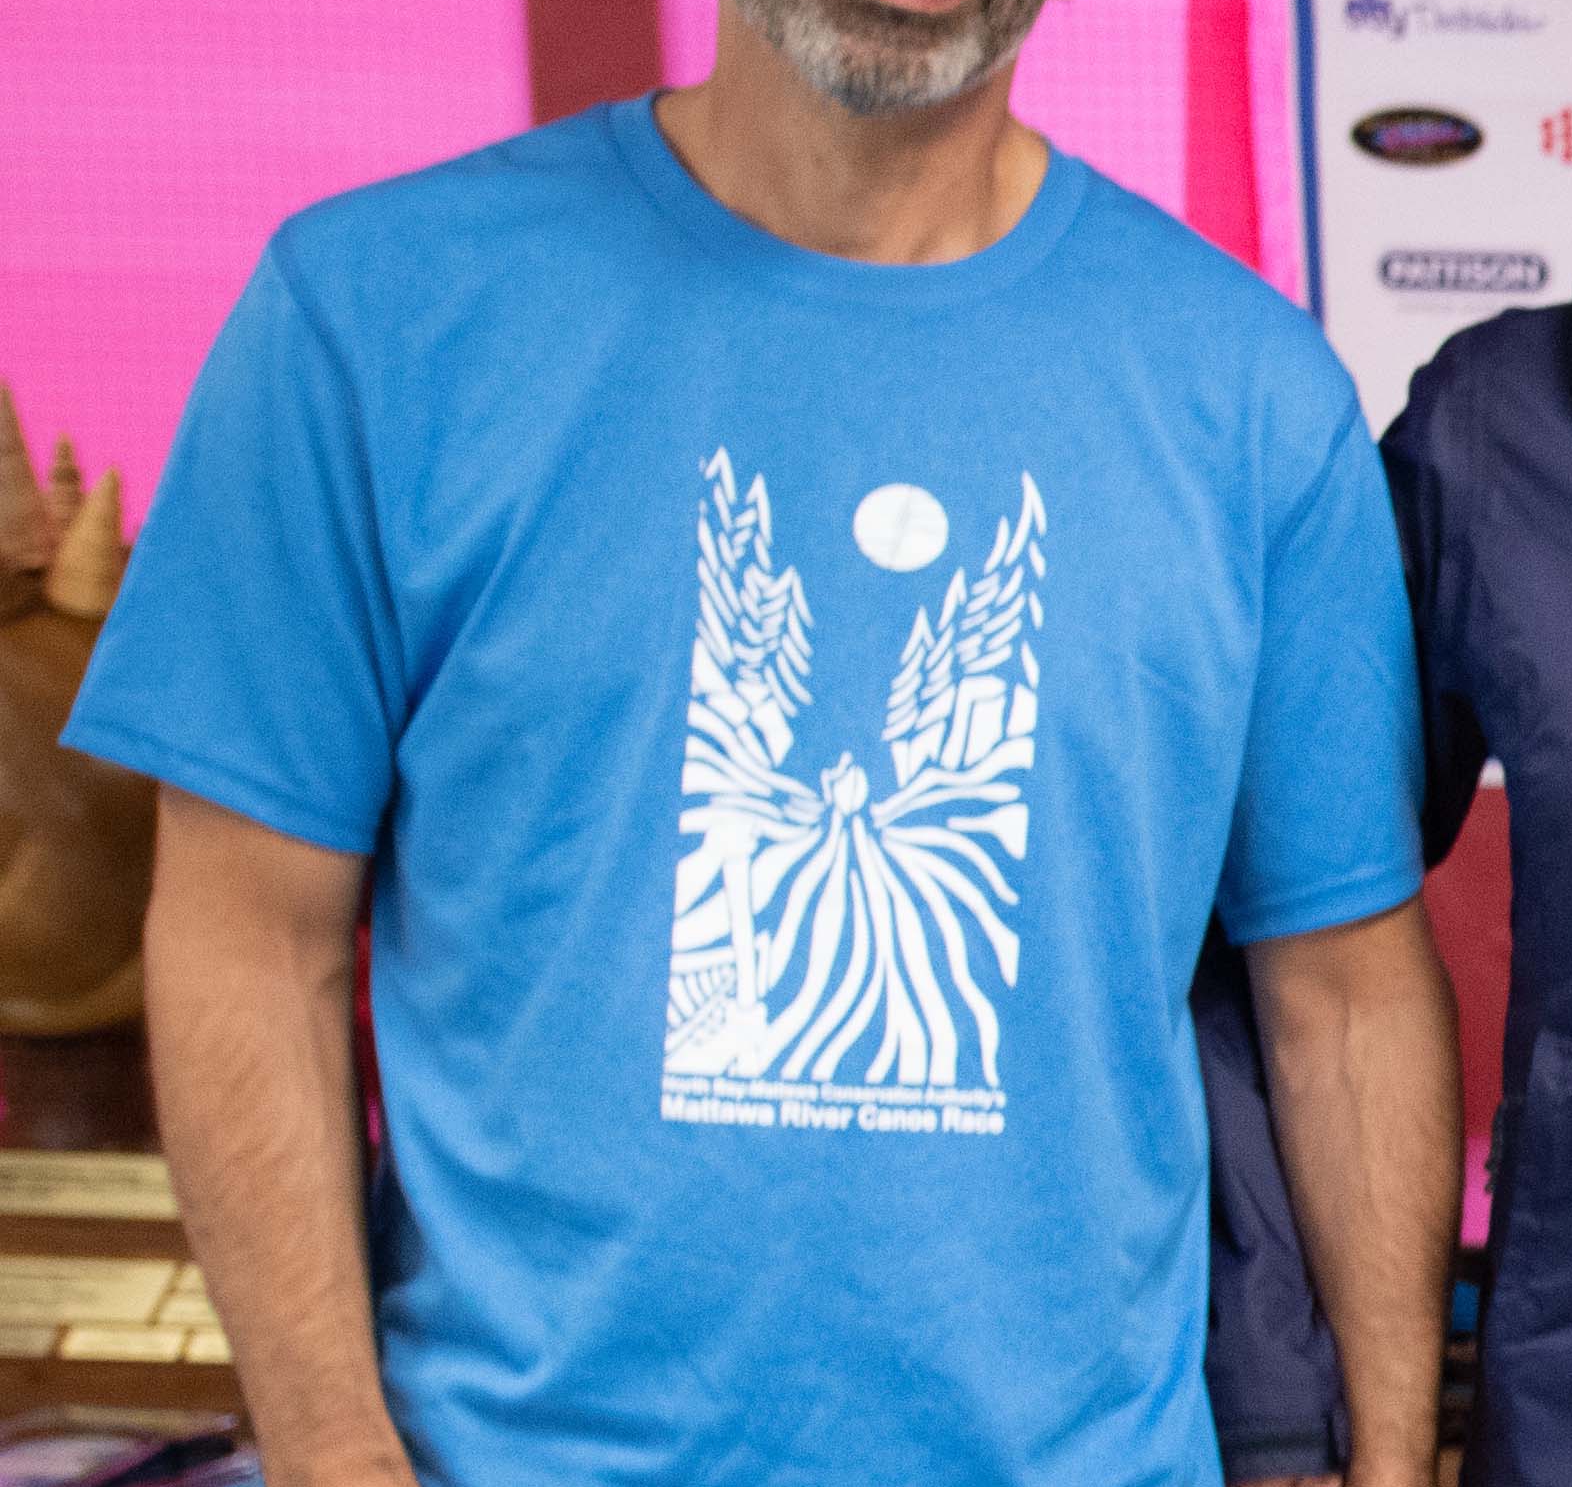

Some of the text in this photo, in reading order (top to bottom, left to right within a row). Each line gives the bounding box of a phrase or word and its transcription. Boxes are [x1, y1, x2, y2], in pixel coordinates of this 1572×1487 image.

[660, 1094, 1005, 1135] Mattawa River Canoe Race
